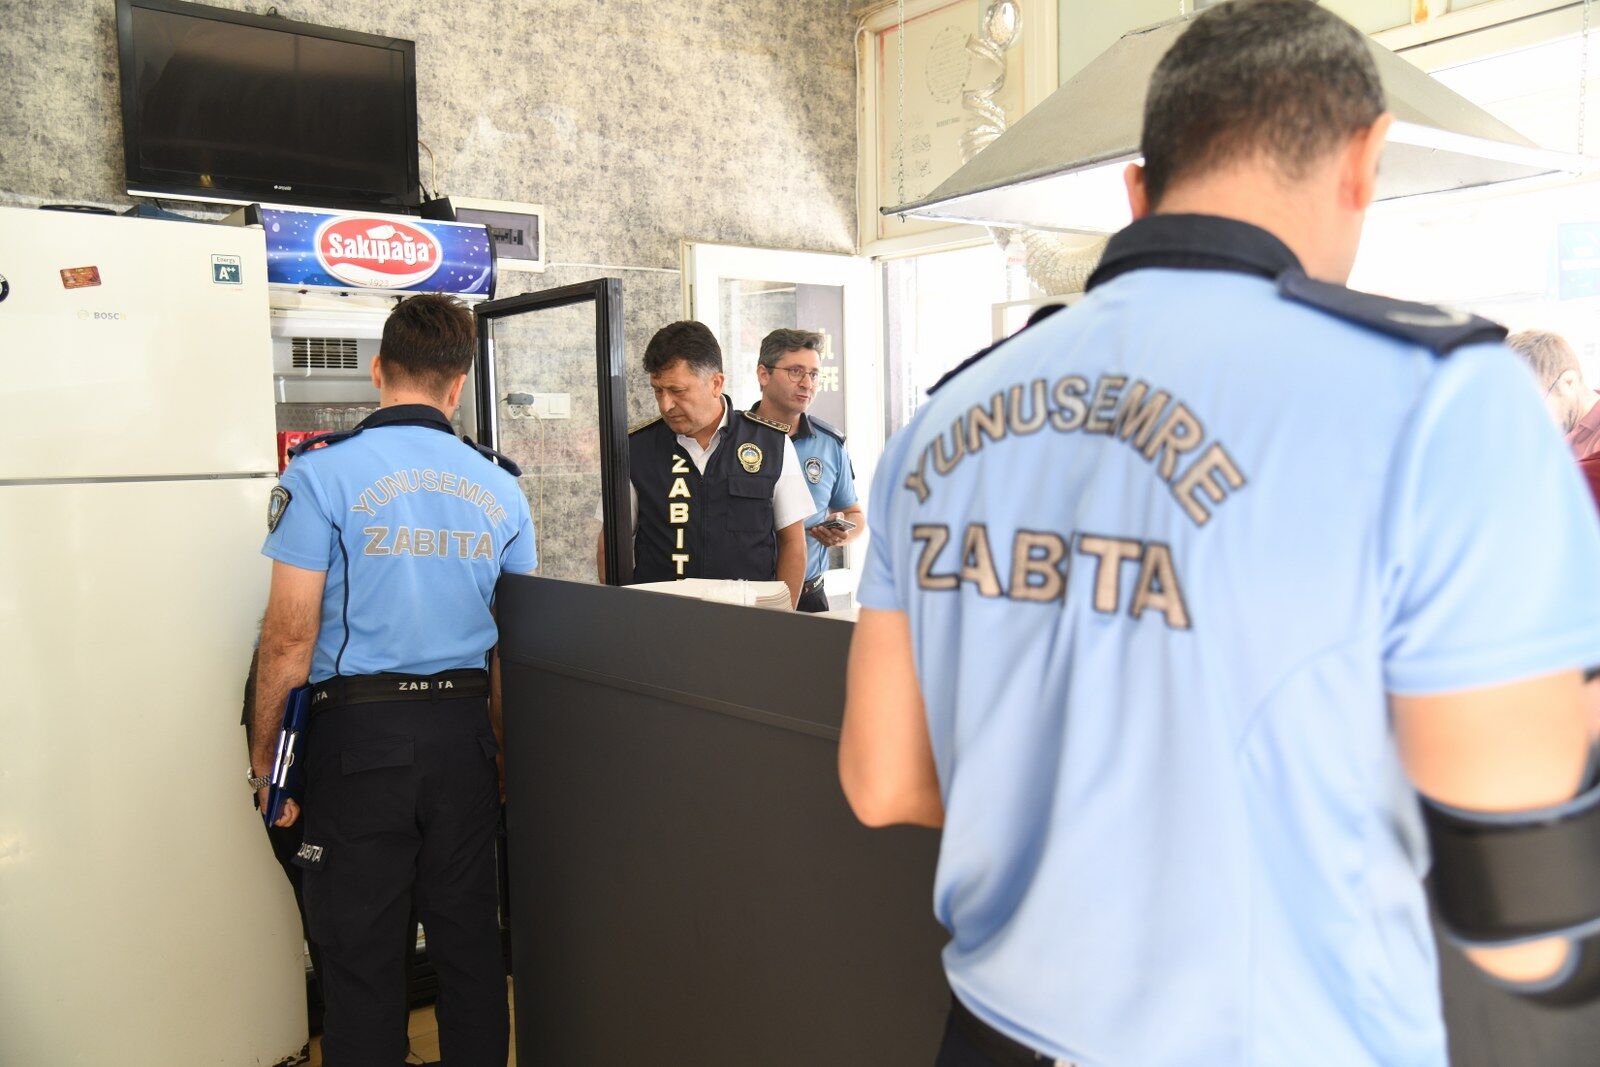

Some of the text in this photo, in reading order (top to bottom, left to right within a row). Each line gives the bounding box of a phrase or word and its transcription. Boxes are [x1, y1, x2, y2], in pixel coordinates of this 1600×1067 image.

[904, 374, 1248, 529] YUNUSEMRE
[351, 467, 508, 529] YUNUSEMRE
[668, 453, 692, 581] ZABIT
[362, 526, 495, 560] ZABITA
[911, 522, 1193, 631] ZABTA
[398, 680, 454, 691] ZABTA
